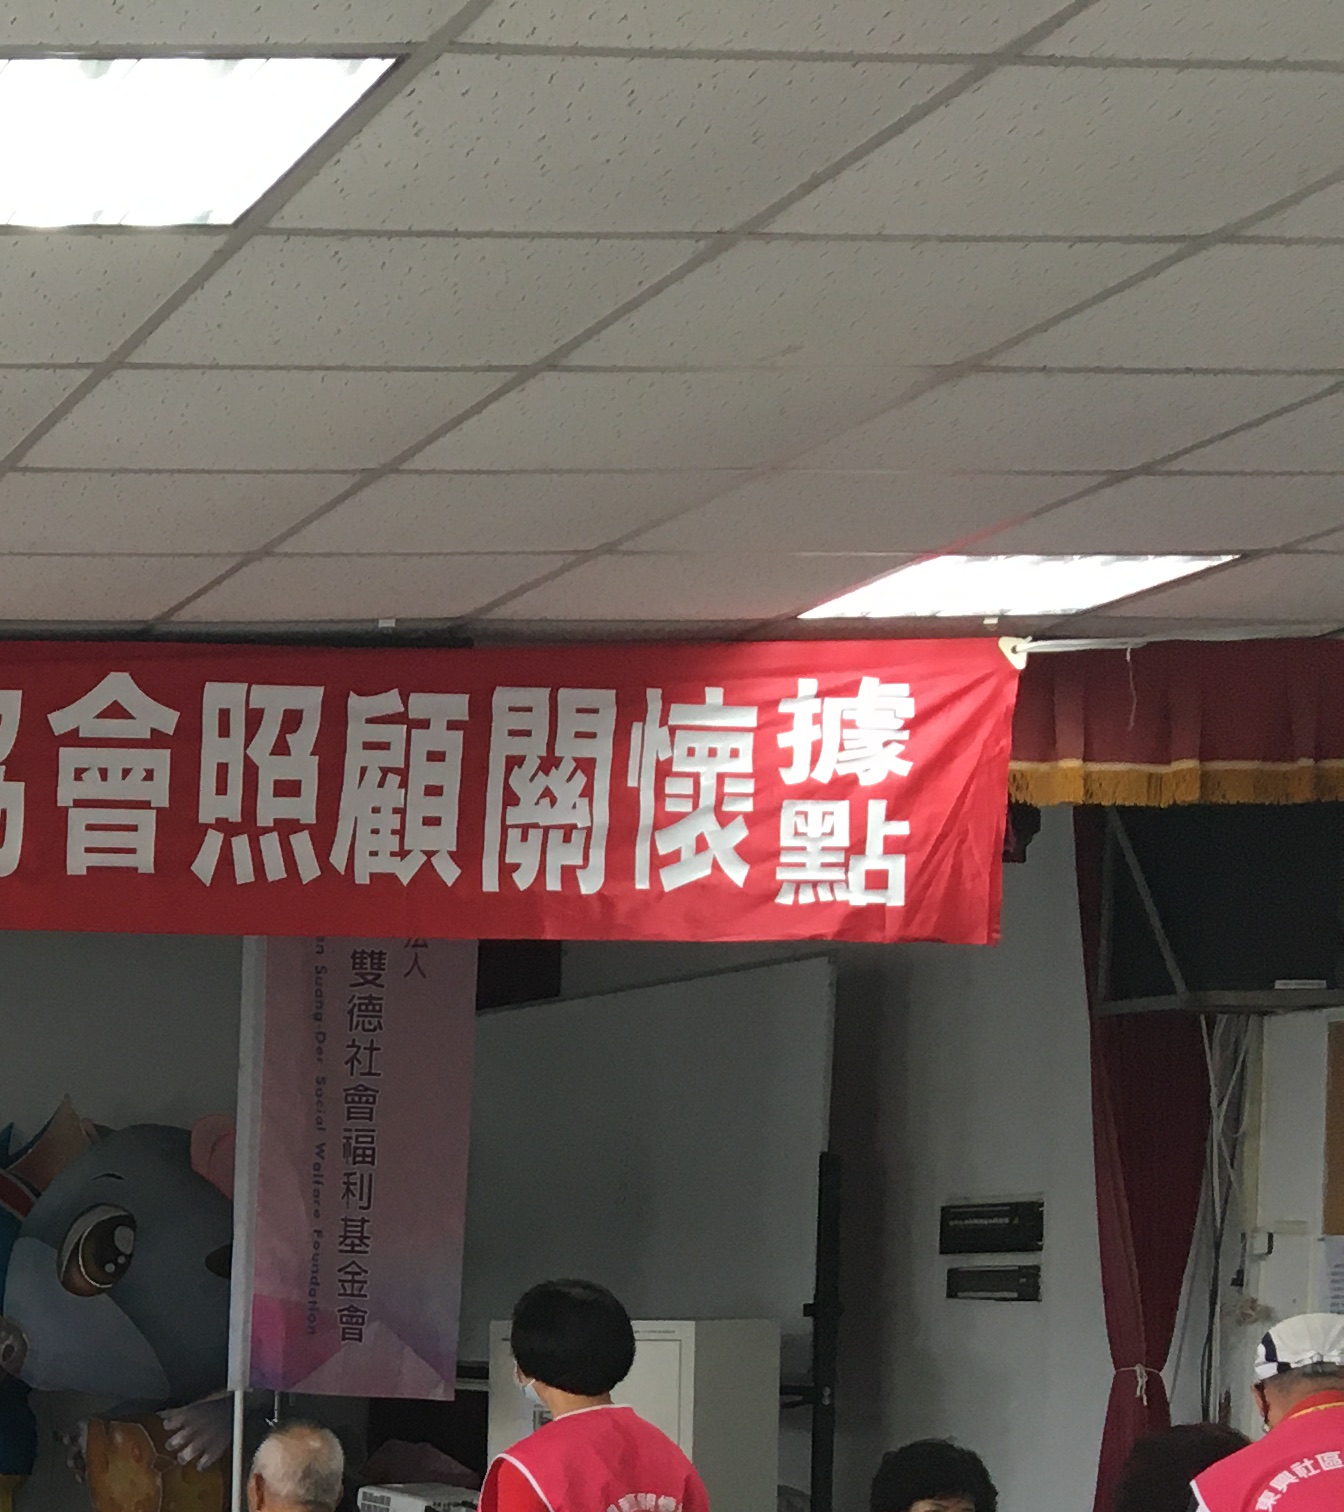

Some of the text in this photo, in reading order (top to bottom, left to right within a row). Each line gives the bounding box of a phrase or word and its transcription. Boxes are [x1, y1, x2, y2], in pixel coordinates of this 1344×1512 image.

[775, 677, 915, 906] 據點
[314, 1076, 327, 1133] Social
[312, 1144, 326, 1220] Welfare
[336, 948, 388, 1344] 雙德社會福利基金會
[1254, 1450, 1344, 1512] 東興社區
